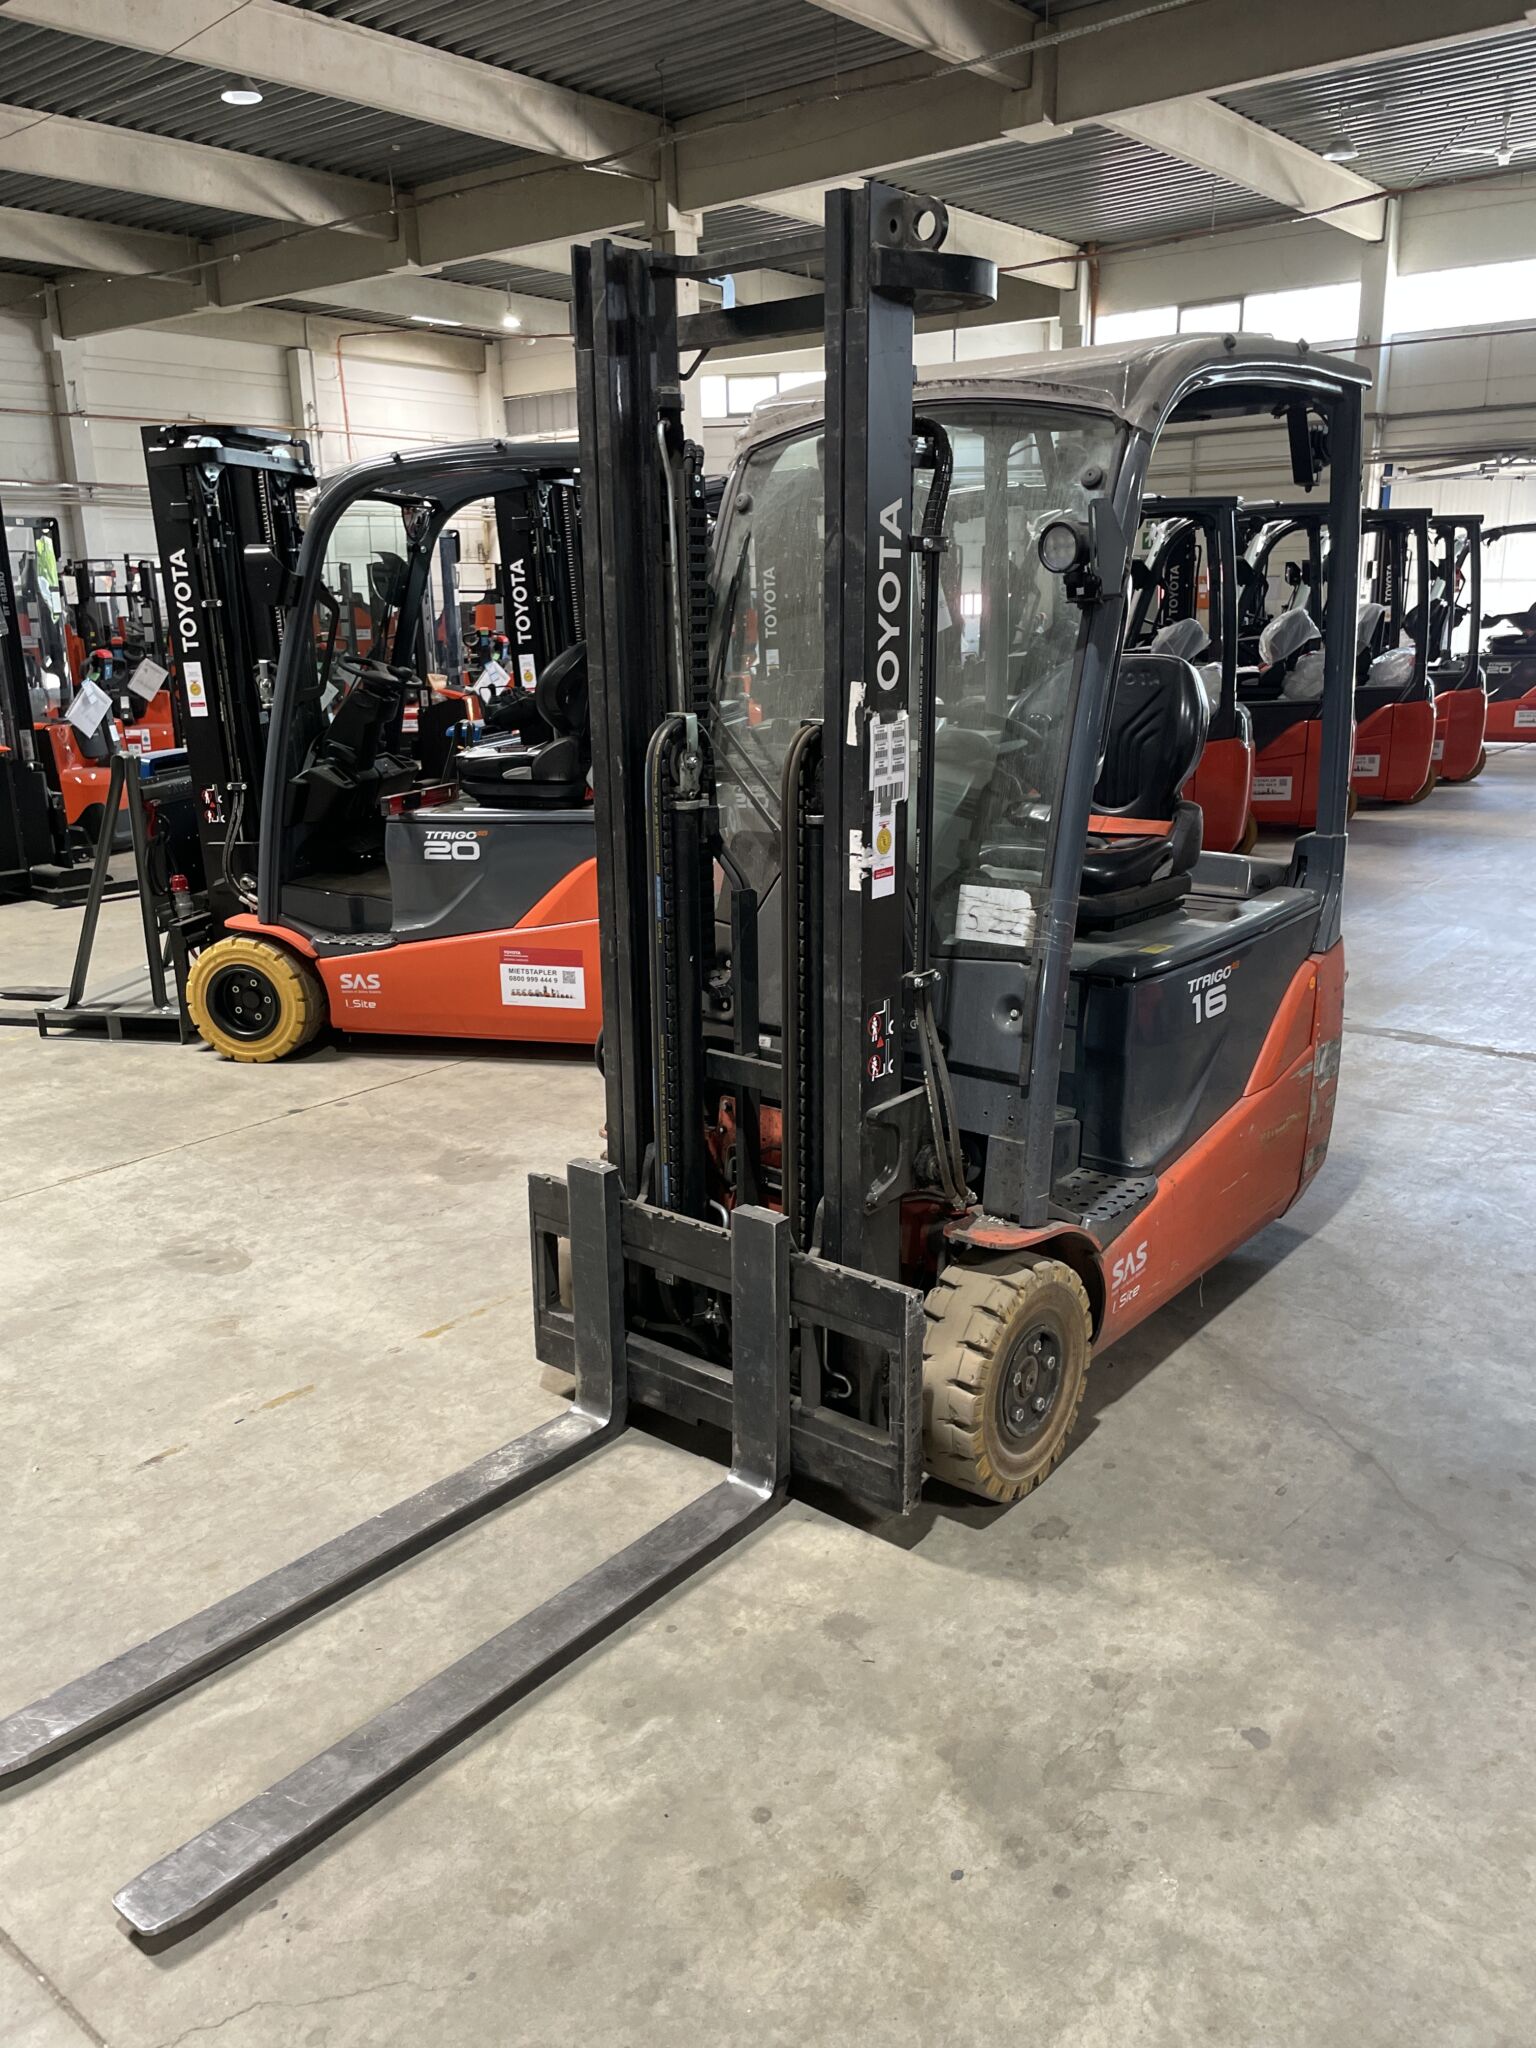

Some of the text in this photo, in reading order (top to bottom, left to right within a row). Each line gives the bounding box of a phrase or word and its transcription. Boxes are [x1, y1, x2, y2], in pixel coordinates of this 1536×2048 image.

[169, 548, 199, 653] TOYOTA
[510, 558, 532, 644] TOYOTA
[763, 566, 777, 638] TOYOTA
[877, 498, 902, 690] OYOTA
[1169, 565, 1180, 616] TOYOTA
[1487, 665, 1511, 673] 20
[424, 841, 480, 860] 20
[340, 973, 381, 990] SAS
[508, 968, 557, 976] MIETSTAPLER
[1192, 984, 1227, 1024] 16
[1112, 1240, 1148, 1290] SAS
